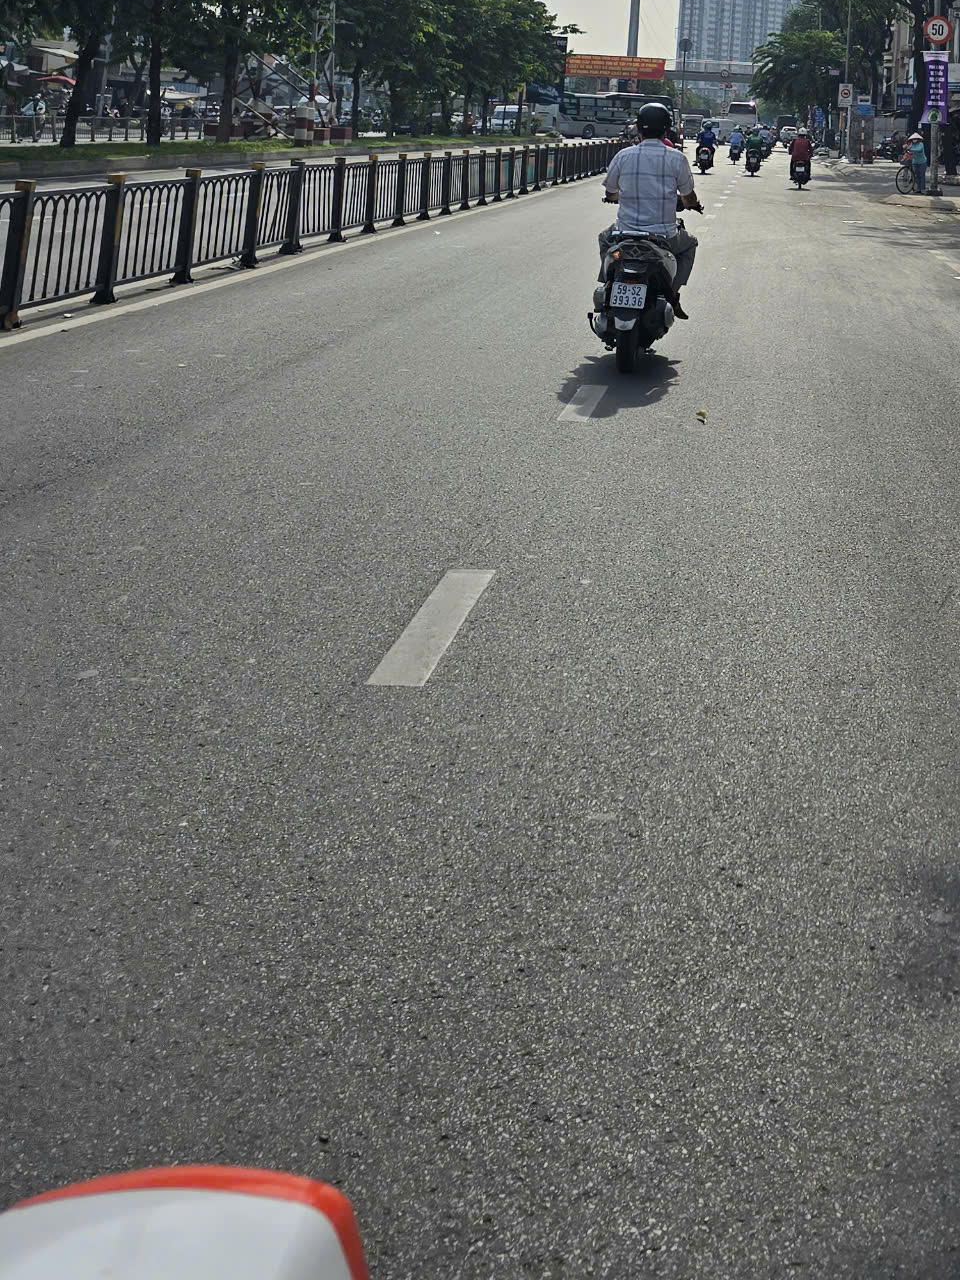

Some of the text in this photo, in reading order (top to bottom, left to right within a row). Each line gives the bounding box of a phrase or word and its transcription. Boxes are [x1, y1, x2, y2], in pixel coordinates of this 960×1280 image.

[931, 23, 944, 36] 50
[617, 284, 642, 296] 59-S2
[612, 295, 643, 307] 393.36
